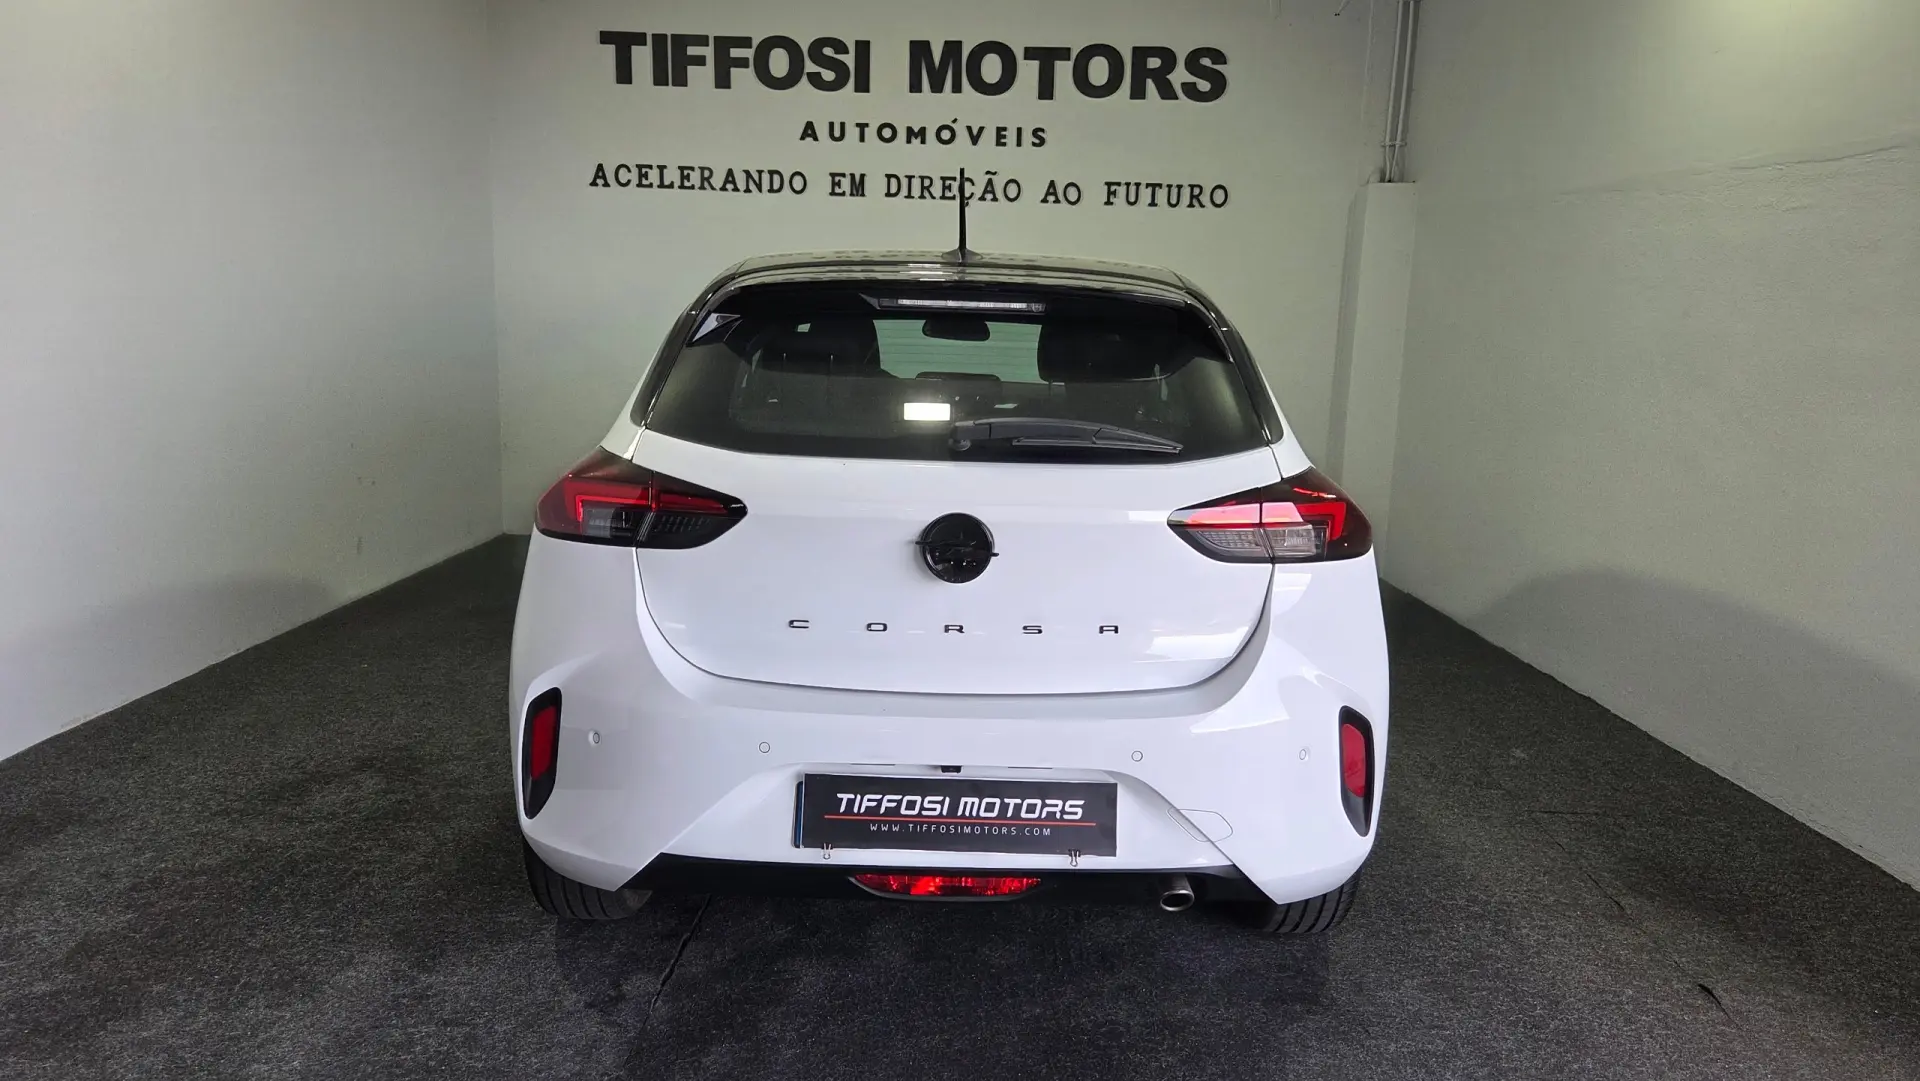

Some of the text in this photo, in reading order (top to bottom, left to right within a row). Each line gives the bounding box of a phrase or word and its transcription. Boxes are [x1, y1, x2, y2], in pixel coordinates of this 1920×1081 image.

[599, 30, 1228, 103] TIFFOSI MOTORS
[799, 117, 1046, 148] AUTOMÓVEIS
[588, 162, 1229, 209] ACELERANDO EM DIREÇÃO AO FUTURO
[788, 618, 1120, 636] CORSA
[836, 792, 1085, 819] TIFFOSI MOTORS
[869, 823, 1051, 836] WWW.TIFFOSIMOTORS.COM
